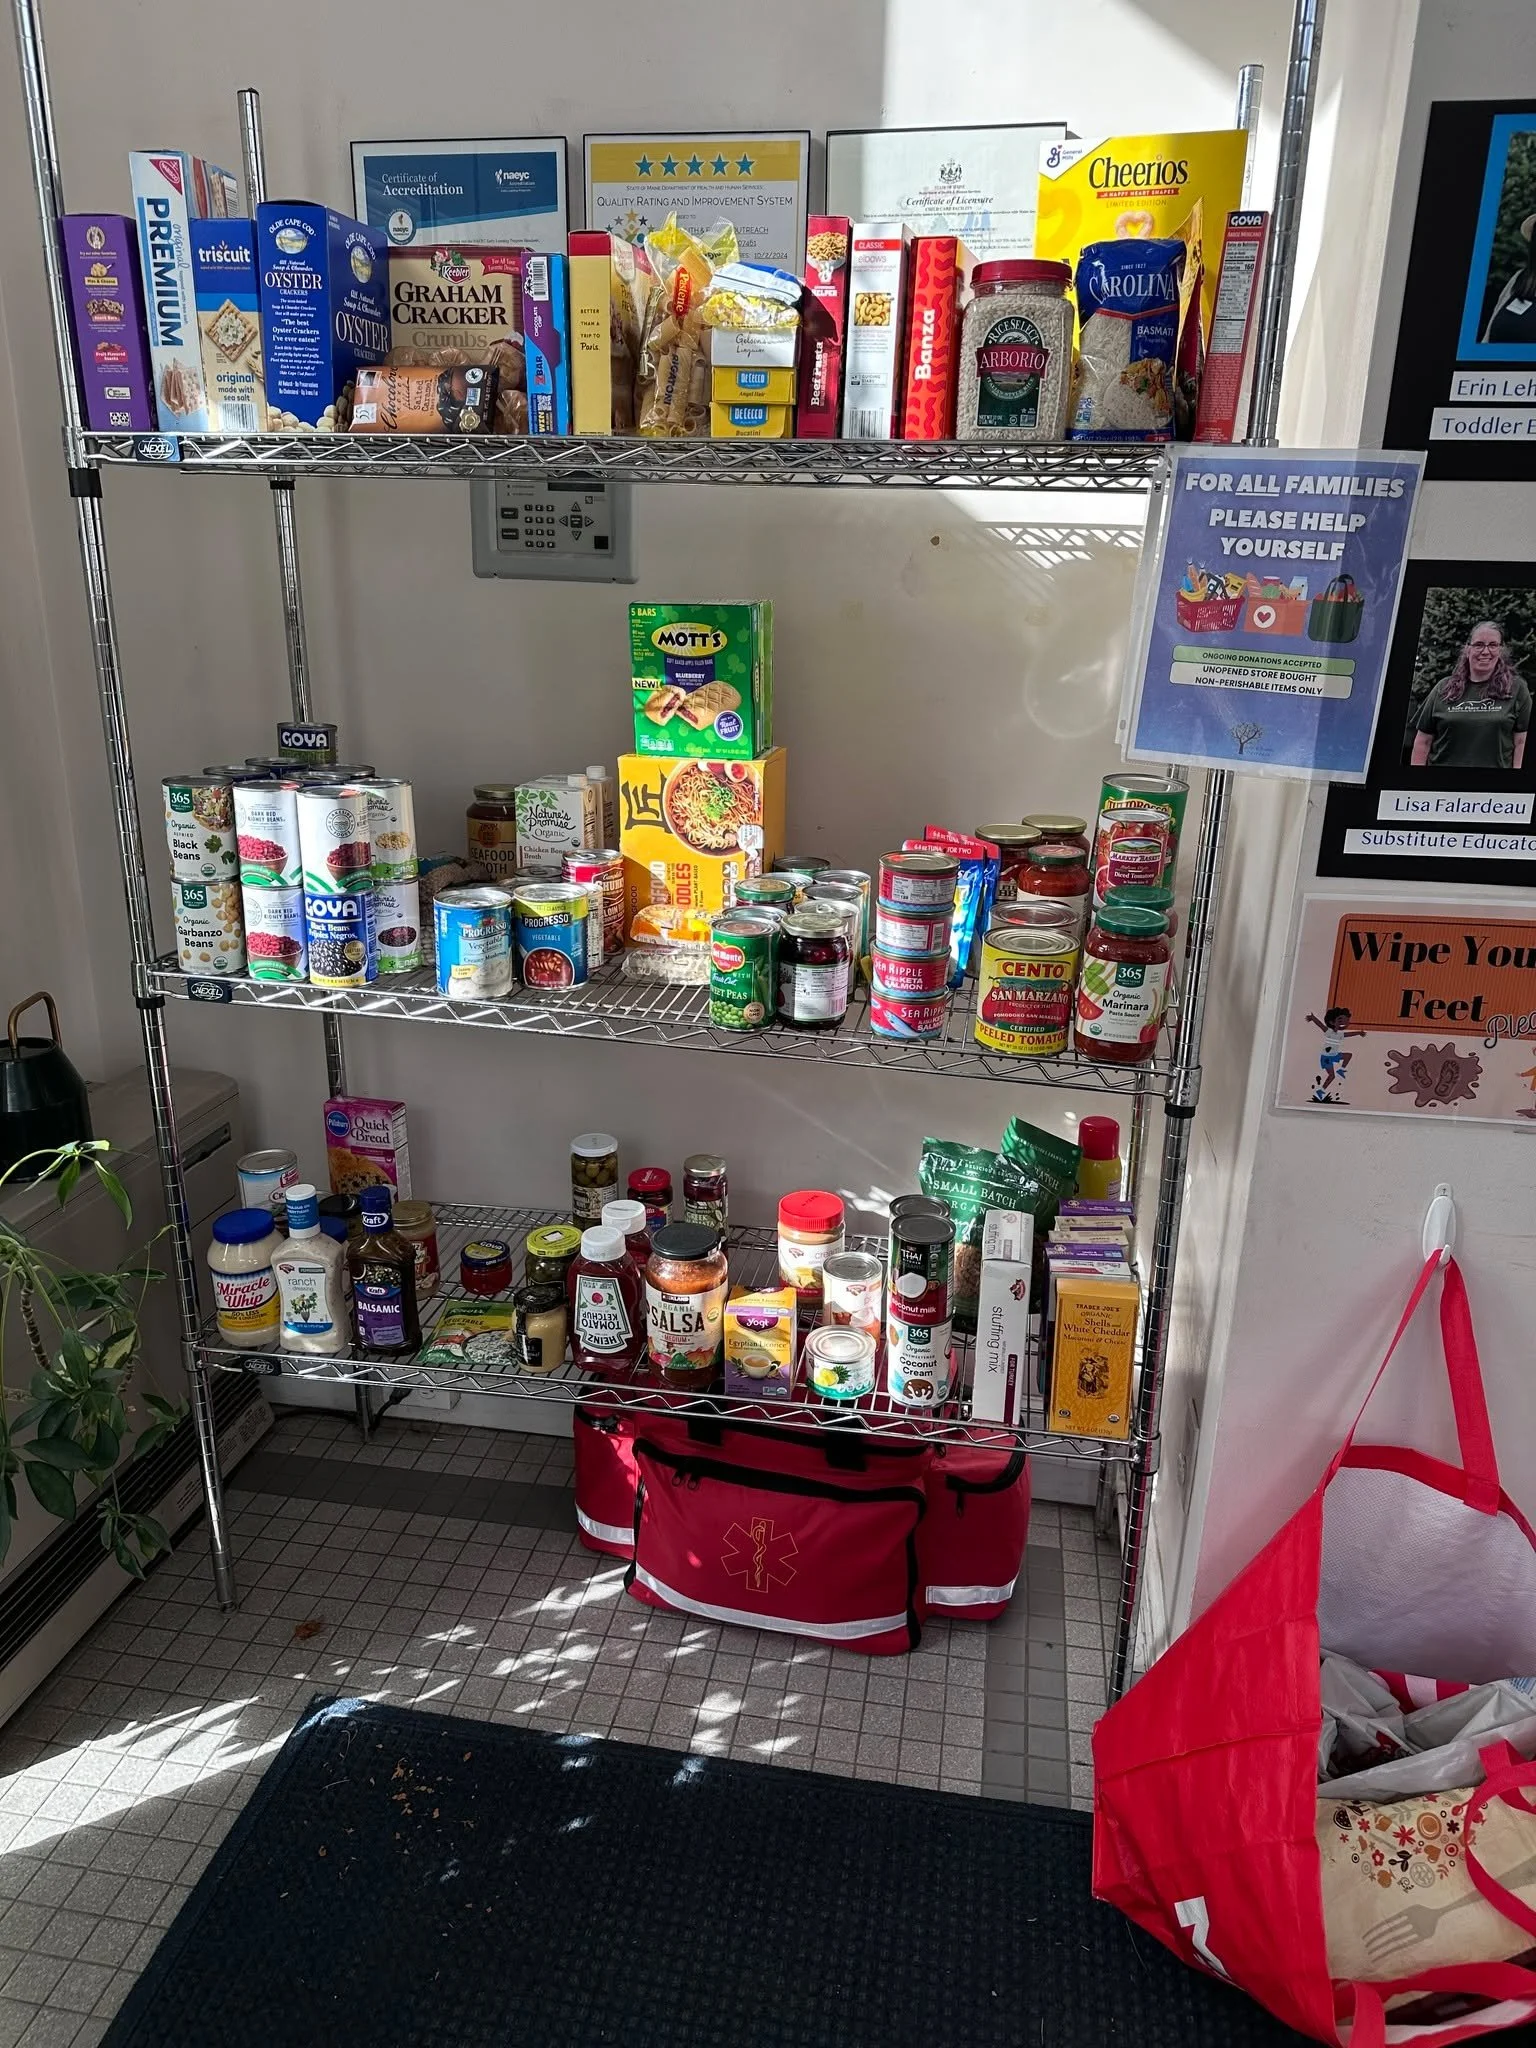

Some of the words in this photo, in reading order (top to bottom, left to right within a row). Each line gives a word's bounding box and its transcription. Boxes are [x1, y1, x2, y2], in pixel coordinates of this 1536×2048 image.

[382, 173, 427, 184] Certificate
[428, 172, 437, 182] of
[503, 170, 530, 180] naeyc
[1089, 155, 1189, 190] Cheerios
[383, 183, 464, 196] Accreditation
[597, 196, 634, 207] QUALITY
[636, 197, 669, 206] RATING
[670, 198, 690, 206] AND
[692, 196, 754, 206] IMPROVEMENT
[757, 195, 793, 206] SYSTEM
[906, 196, 945, 207] Certificate
[954, 195, 994, 205] Licensure
[1106, 200, 1135, 208] LIMITED
[1136, 199, 1167, 207] EDITION
[268, 219, 285, 234] OLDE
[285, 218, 302, 227] CAPE
[302, 222, 315, 236] COD
[1230, 216, 1262, 227] GOYA
[172, 223, 190, 269] original
[199, 245, 251, 263] triscuit
[858, 254, 887, 263] elbows
[146, 198, 184, 346] PREMIUM
[442, 267, 470, 280] Keebler
[264, 271, 323, 290] OYSTER
[394, 281, 502, 304] GRAHAM
[675, 272, 691, 313] Pastene
[1089, 271, 1176, 304] CAROLINA
[392, 303, 508, 326] CRACKER
[335, 310, 389, 352] OYSTER
[1136, 325, 1174, 337] BASMATI
[412, 331, 488, 349] Crumbs
[915, 309, 936, 380] Banza
[980, 351, 1045, 370] ARBORIO
[216, 372, 255, 385] original
[664, 353, 679, 406] RIGATONI
[238, 386, 255, 394] with
[811, 375, 822, 406] Beef
[1457, 378, 1497, 396] Erin
[1442, 417, 1523, 434] Toddler
[142, 444, 171, 454] NEXEL
[1185, 473, 1234, 492] FOR
[1236, 473, 1280, 496] ALL
[1284, 475, 1406, 499] FAMILIES
[1209, 508, 1297, 530] PLEASE
[1302, 511, 1366, 533] HELP
[1220, 537, 1346, 561] YOURSELF
[631, 609, 636, 617] 5
[637, 608, 656, 617] BARS
[657, 631, 722, 648] MOTT'S
[1202, 652, 1238, 661] ONGOING
[1238, 655, 1282, 665] DONATIONS
[1283, 659, 1322, 669] ACCEPTED
[1203, 665, 1249, 676] UNOPENED
[1250, 669, 1278, 679] STORE
[1280, 672, 1317, 682] BOUGHT
[634, 680, 660, 689] NEW!
[1195, 676, 1270, 690] NON-PERISHABLE
[1270, 683, 1297, 693] ITEMS
[1298, 686, 1323, 695] ONLY
[719, 725, 739, 735] FRUIT
[281, 732, 328, 748] GOYA
[171, 792, 190, 806] 365
[620, 769, 673, 835] 匠
[527, 804, 571, 821] Nature's
[1395, 797, 1430, 812] Lisa
[1435, 798, 1526, 815] Falardeau
[171, 819, 197, 831] Organic
[526, 817, 576, 832] Promise
[534, 828, 565, 838] Organic
[1361, 831, 1458, 848] Substitute
[173, 839, 199, 850] Black
[173, 850, 201, 861] Beans
[471, 849, 515, 862] SEAFOOD
[1110, 852, 1137, 862] MARKET
[1138, 854, 1161, 862] BASKET
[1114, 871, 1129, 879] Diced
[183, 889, 204, 901] 365
[306, 900, 358, 918] GOYA
[183, 915, 210, 926] Organic
[328, 922, 349, 932] Beans
[524, 914, 569, 928] PROGRESSO
[177, 926, 223, 938] Garbanzo
[463, 922, 507, 938] PROGRESSO
[184, 938, 214, 948] Beans
[532, 934, 561, 942] VEGETABLE
[1347, 931, 1451, 973] Wipe
[874, 959, 887, 972] SEA
[888, 964, 923, 977] RIPPLE
[1002, 962, 1065, 979] CENTO
[1118, 967, 1142, 980] 365
[885, 980, 923, 991] SALMON
[900, 976, 923, 984] KETA
[194, 987, 223, 997] NEXEL
[726, 989, 748, 1000] PEAS
[991, 989, 1015, 1001] SAN
[1019, 992, 1069, 1004] MARZANO
[1112, 989, 1141, 1000] Organic
[1101, 998, 1150, 1012] Marinara
[1398, 989, 1489, 1023] Feet
[901, 1006, 920, 1018] SEA
[1108, 1010, 1123, 1018] Pasta
[979, 1025, 1016, 1043] PEELED
[1010, 1024, 1045, 1033] CERTIFIED
[354, 1116, 390, 1132] Quick
[351, 1127, 391, 1144] Bread
[933, 1179, 977, 1196] SMALL
[981, 1187, 1017, 1209] BATCH
[362, 1216, 382, 1225] Kraft
[480, 1241, 503, 1251] GOYA
[902, 1249, 923, 1261] THAI
[216, 1276, 270, 1297] Miracle
[288, 1277, 317, 1286] ranch
[368, 1286, 384, 1294] Kraft
[224, 1292, 264, 1309] Whip
[357, 1300, 400, 1314] BALSAMIC
[657, 1302, 696, 1312] ORGANIC
[920, 1305, 936, 1314] milk
[581, 1312, 619, 1322] KETCHUP
[651, 1307, 706, 1333] SALSA
[1084, 1318, 1111, 1328] Shells
[581, 1320, 622, 1331] TOMATO
[988, 1306, 1003, 1353] stuffing
[1063, 1322, 1090, 1334] White
[1092, 1325, 1131, 1337] Cheddar
[588, 1333, 618, 1345] HEINZ
[664, 1335, 688, 1343] MEDIUM
[909, 1328, 929, 1338] 365
[728, 1339, 758, 1348] Egyptian
[759, 1340, 787, 1348] Licorice
[905, 1343, 932, 1355] Organic
[899, 1356, 938, 1369] Coconut
[988, 1354, 1000, 1373] mix
[902, 1367, 933, 1377] Cream
